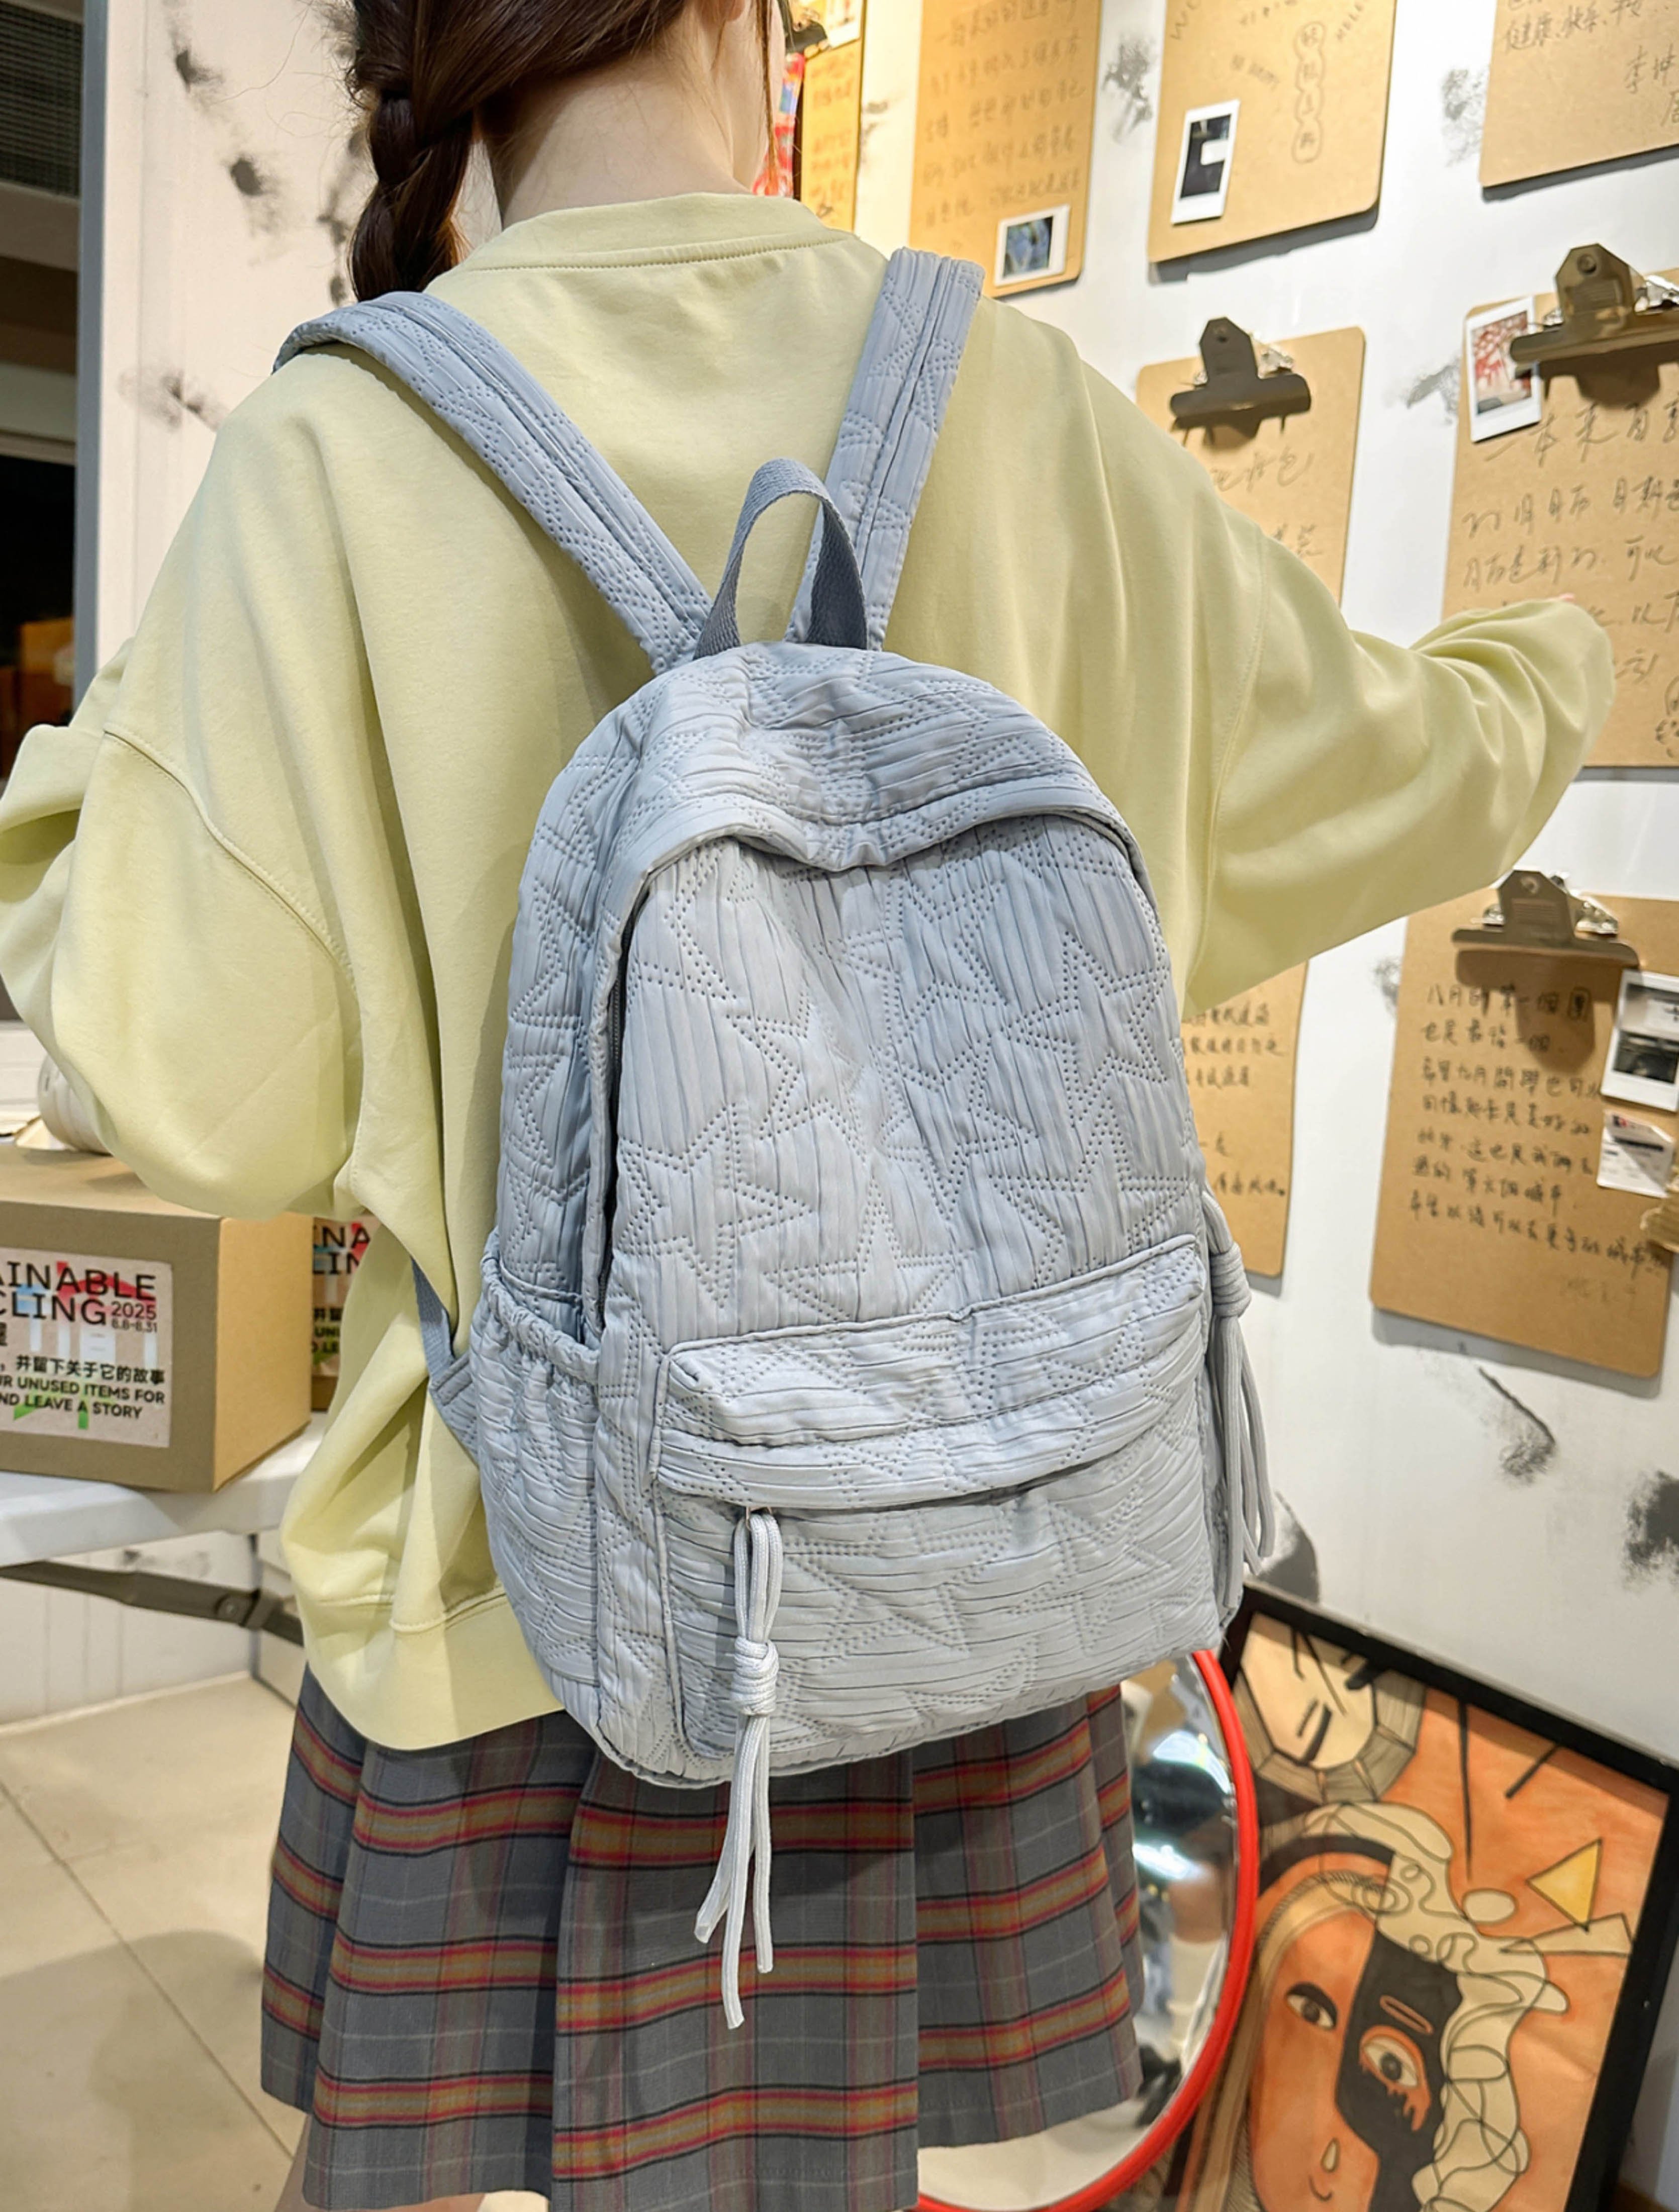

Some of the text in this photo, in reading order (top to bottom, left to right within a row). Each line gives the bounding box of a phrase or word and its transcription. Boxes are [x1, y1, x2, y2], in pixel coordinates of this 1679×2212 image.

[313, 1225, 370, 1248] NA
[0, 1261, 156, 1301] INABLE
[0, 1290, 106, 1325] LING
[111, 1301, 156, 1320] 2025
[18, 1375, 79, 1395] UNUSED
[84, 1384, 130, 1401] ITEMS
[135, 1389, 165, 1404] FOR
[25, 1395, 73, 1412] LEAVE
[77, 1401, 88, 1413] A
[92, 1402, 143, 1419] STORY
